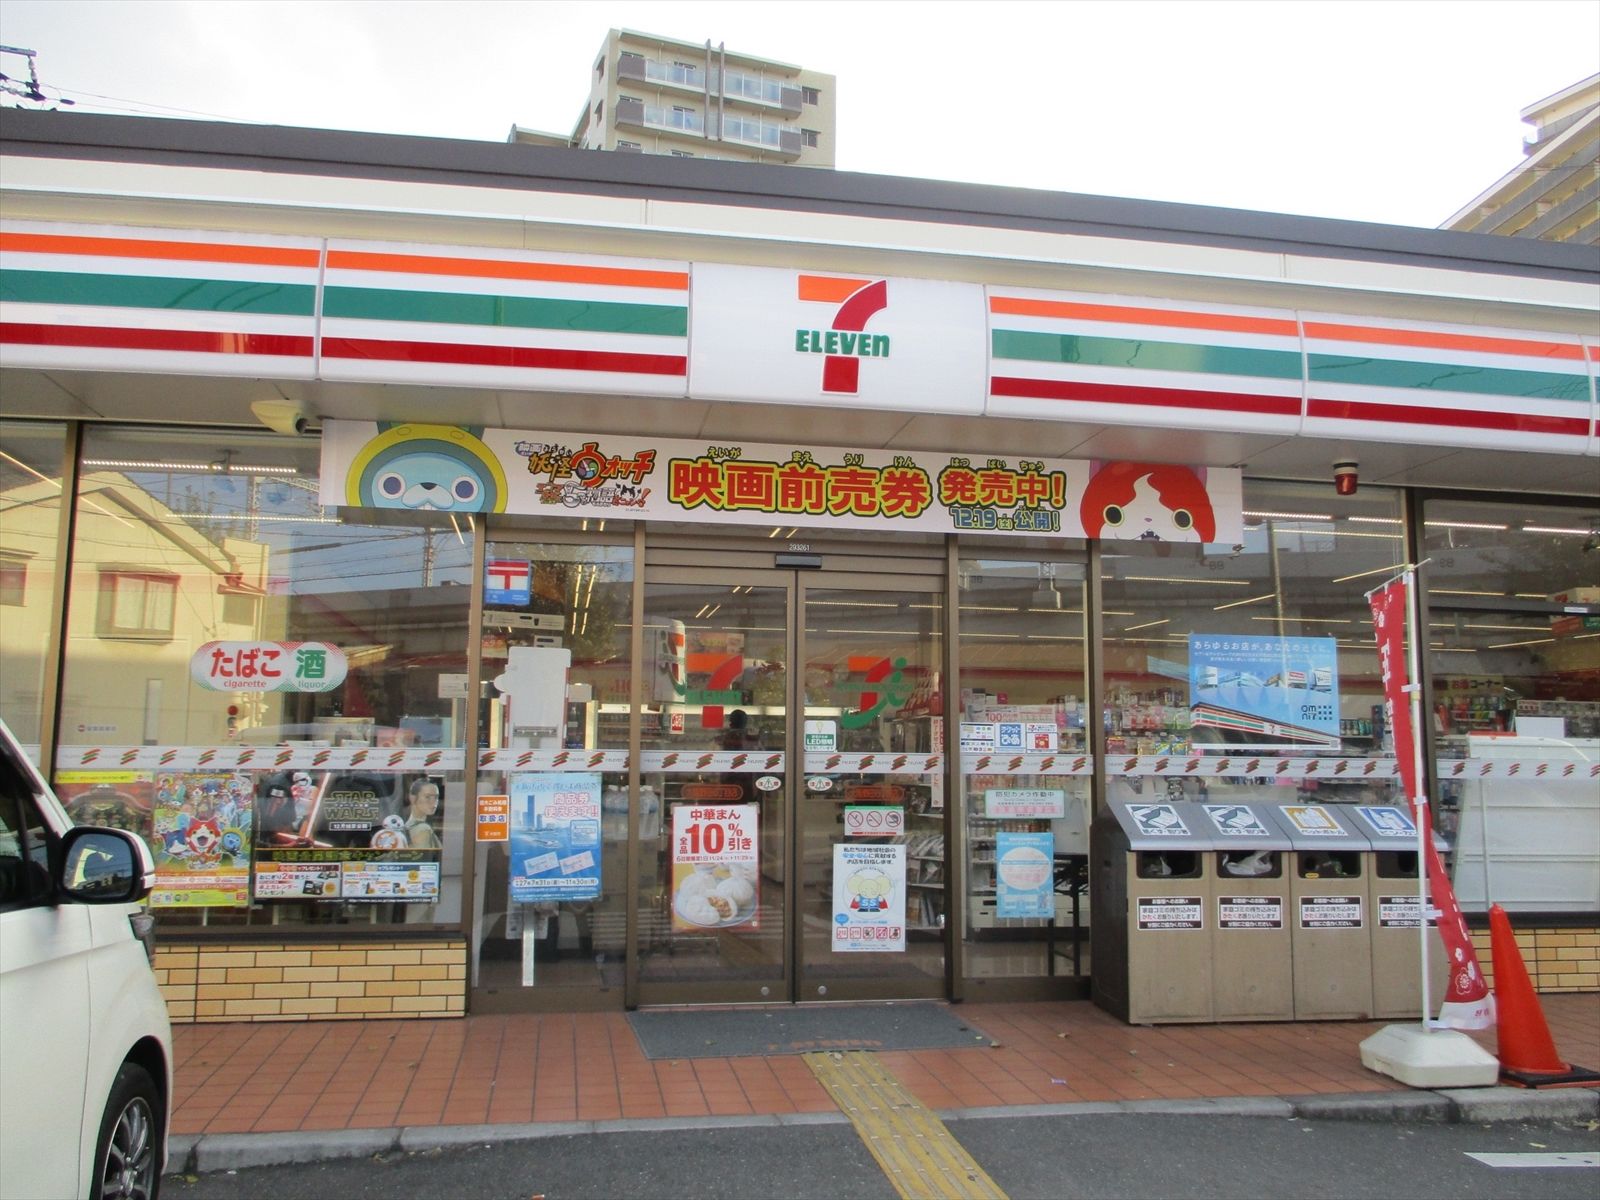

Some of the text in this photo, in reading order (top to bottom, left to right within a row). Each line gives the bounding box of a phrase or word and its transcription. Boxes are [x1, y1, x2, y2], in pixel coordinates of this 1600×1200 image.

[797, 274, 887, 393] 7
[708, 447, 741, 458] えいが
[792, 451, 813, 462] まえ
[843, 453, 864, 464] うり
[894, 457, 915, 468] けん
[951, 457, 970, 467] はつ
[670, 459, 1065, 517] 映画前売券 発売中!
[211, 648, 327, 679] たばこ 酒
[224, 680, 266, 688] cigarette
[323, 791, 379, 803] STAR
[323, 807, 379, 820] WARS
[690, 808, 741, 820] 中華まん
[685, 823, 724, 854] 10
[728, 838, 752, 850] 引き
